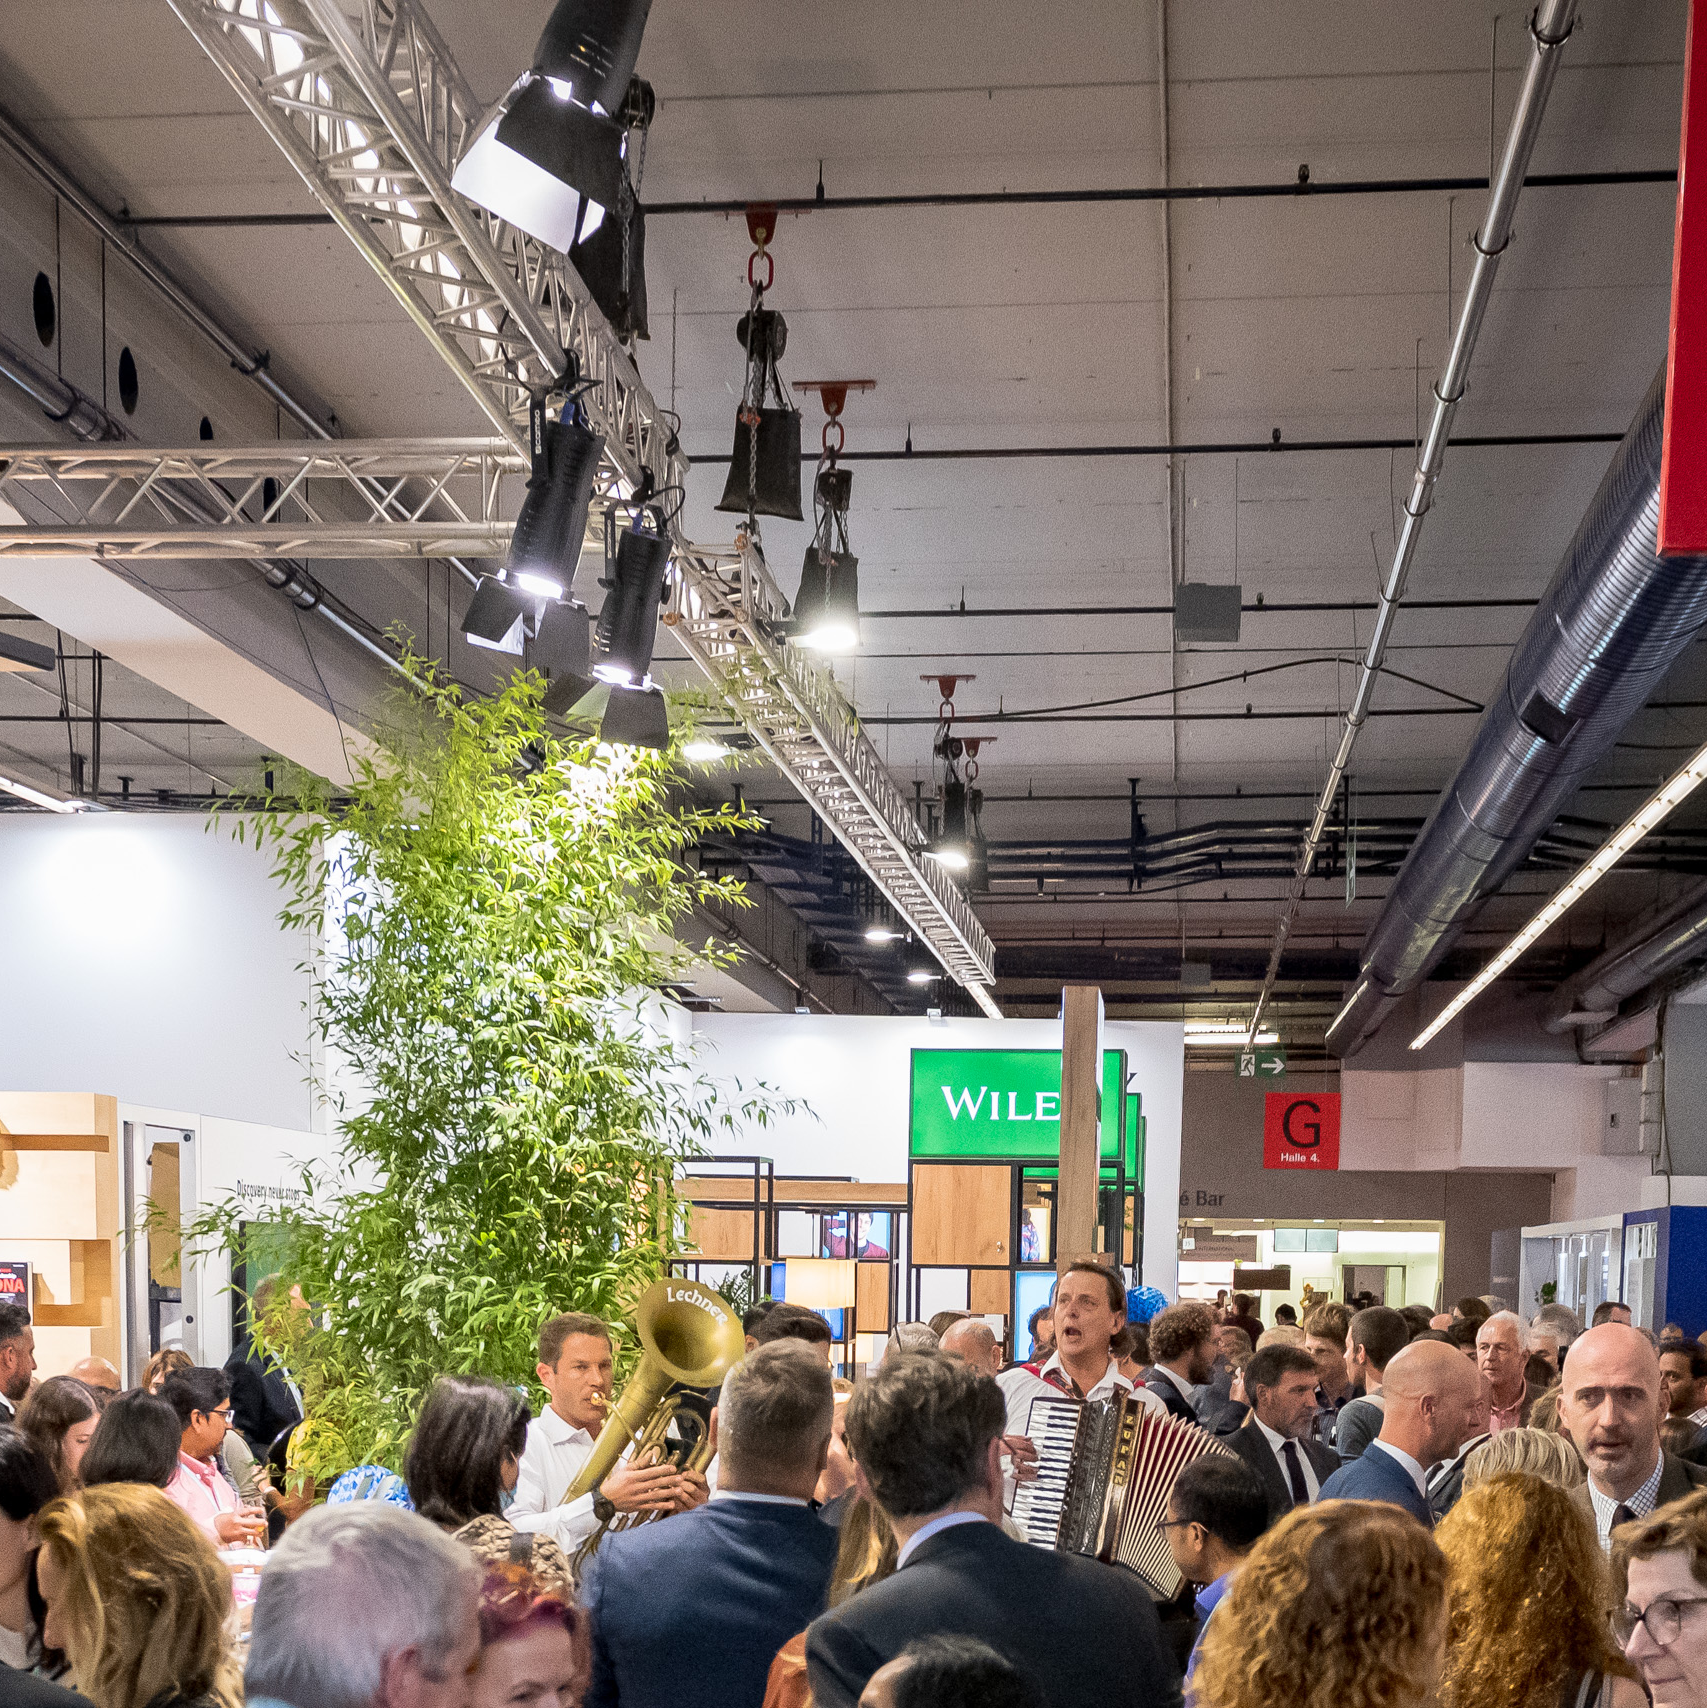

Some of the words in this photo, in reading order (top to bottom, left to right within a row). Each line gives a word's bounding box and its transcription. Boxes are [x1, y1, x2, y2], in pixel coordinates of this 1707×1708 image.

[1283, 1100, 1320, 1148] G
[1281, 1153, 1307, 1163] Halle
[1196, 1190, 1225, 1206] Bar
[1114, 1415, 1134, 1486] ZUPAN
